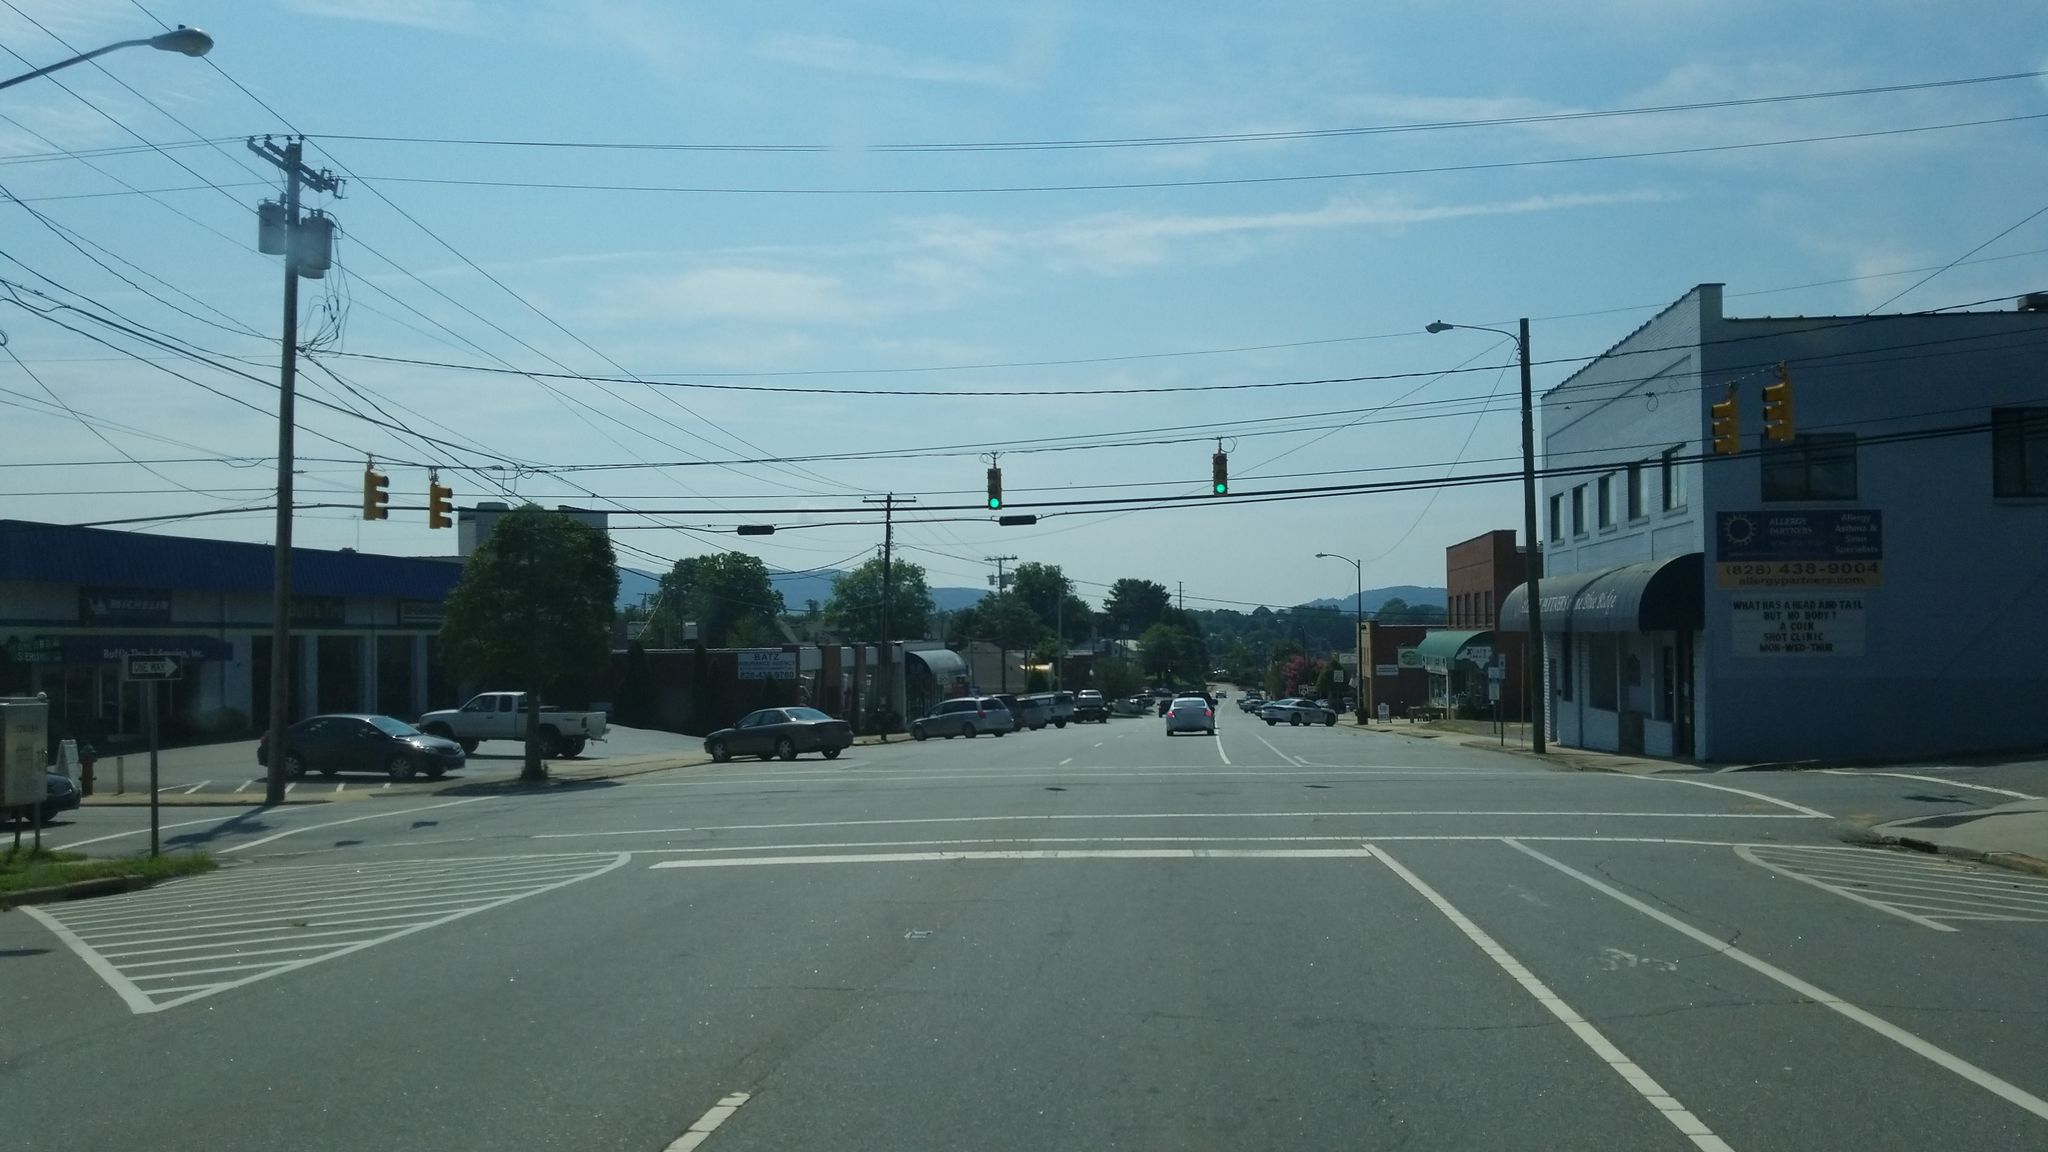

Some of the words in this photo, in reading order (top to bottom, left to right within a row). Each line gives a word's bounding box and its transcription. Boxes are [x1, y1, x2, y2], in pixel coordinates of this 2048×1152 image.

[1768, 517, 1808, 526] ALLERGY
[1841, 513, 1871, 524] Allergy
[1769, 527, 1812, 536] PARTNERS
[1726, 564, 1771, 575] (828)
[1779, 562, 1879, 575] 438-9004
[1738, 576, 1865, 587] allergypartners.com
[110, 599, 169, 610] MICHELIN
[1732, 601, 1761, 610] WHAT
[1763, 601, 1781, 610] HAS
[1784, 601, 1791, 610] A
[1792, 601, 1817, 610] HEAD
[1818, 601, 1838, 610] AND
[1839, 600, 1864, 610] TAIL
[1764, 611, 1781, 621] BUT
[1787, 611, 1800, 621] NO
[1779, 622, 1787, 631] A
[1790, 622, 1815, 631] COIN
[1764, 632, 1787, 642] SHOT
[1790, 632, 1823, 642] CLINIC
[753, 653, 780, 661] BATZ
[133, 662, 149, 673] ONE
[150, 662, 166, 673] WAY
